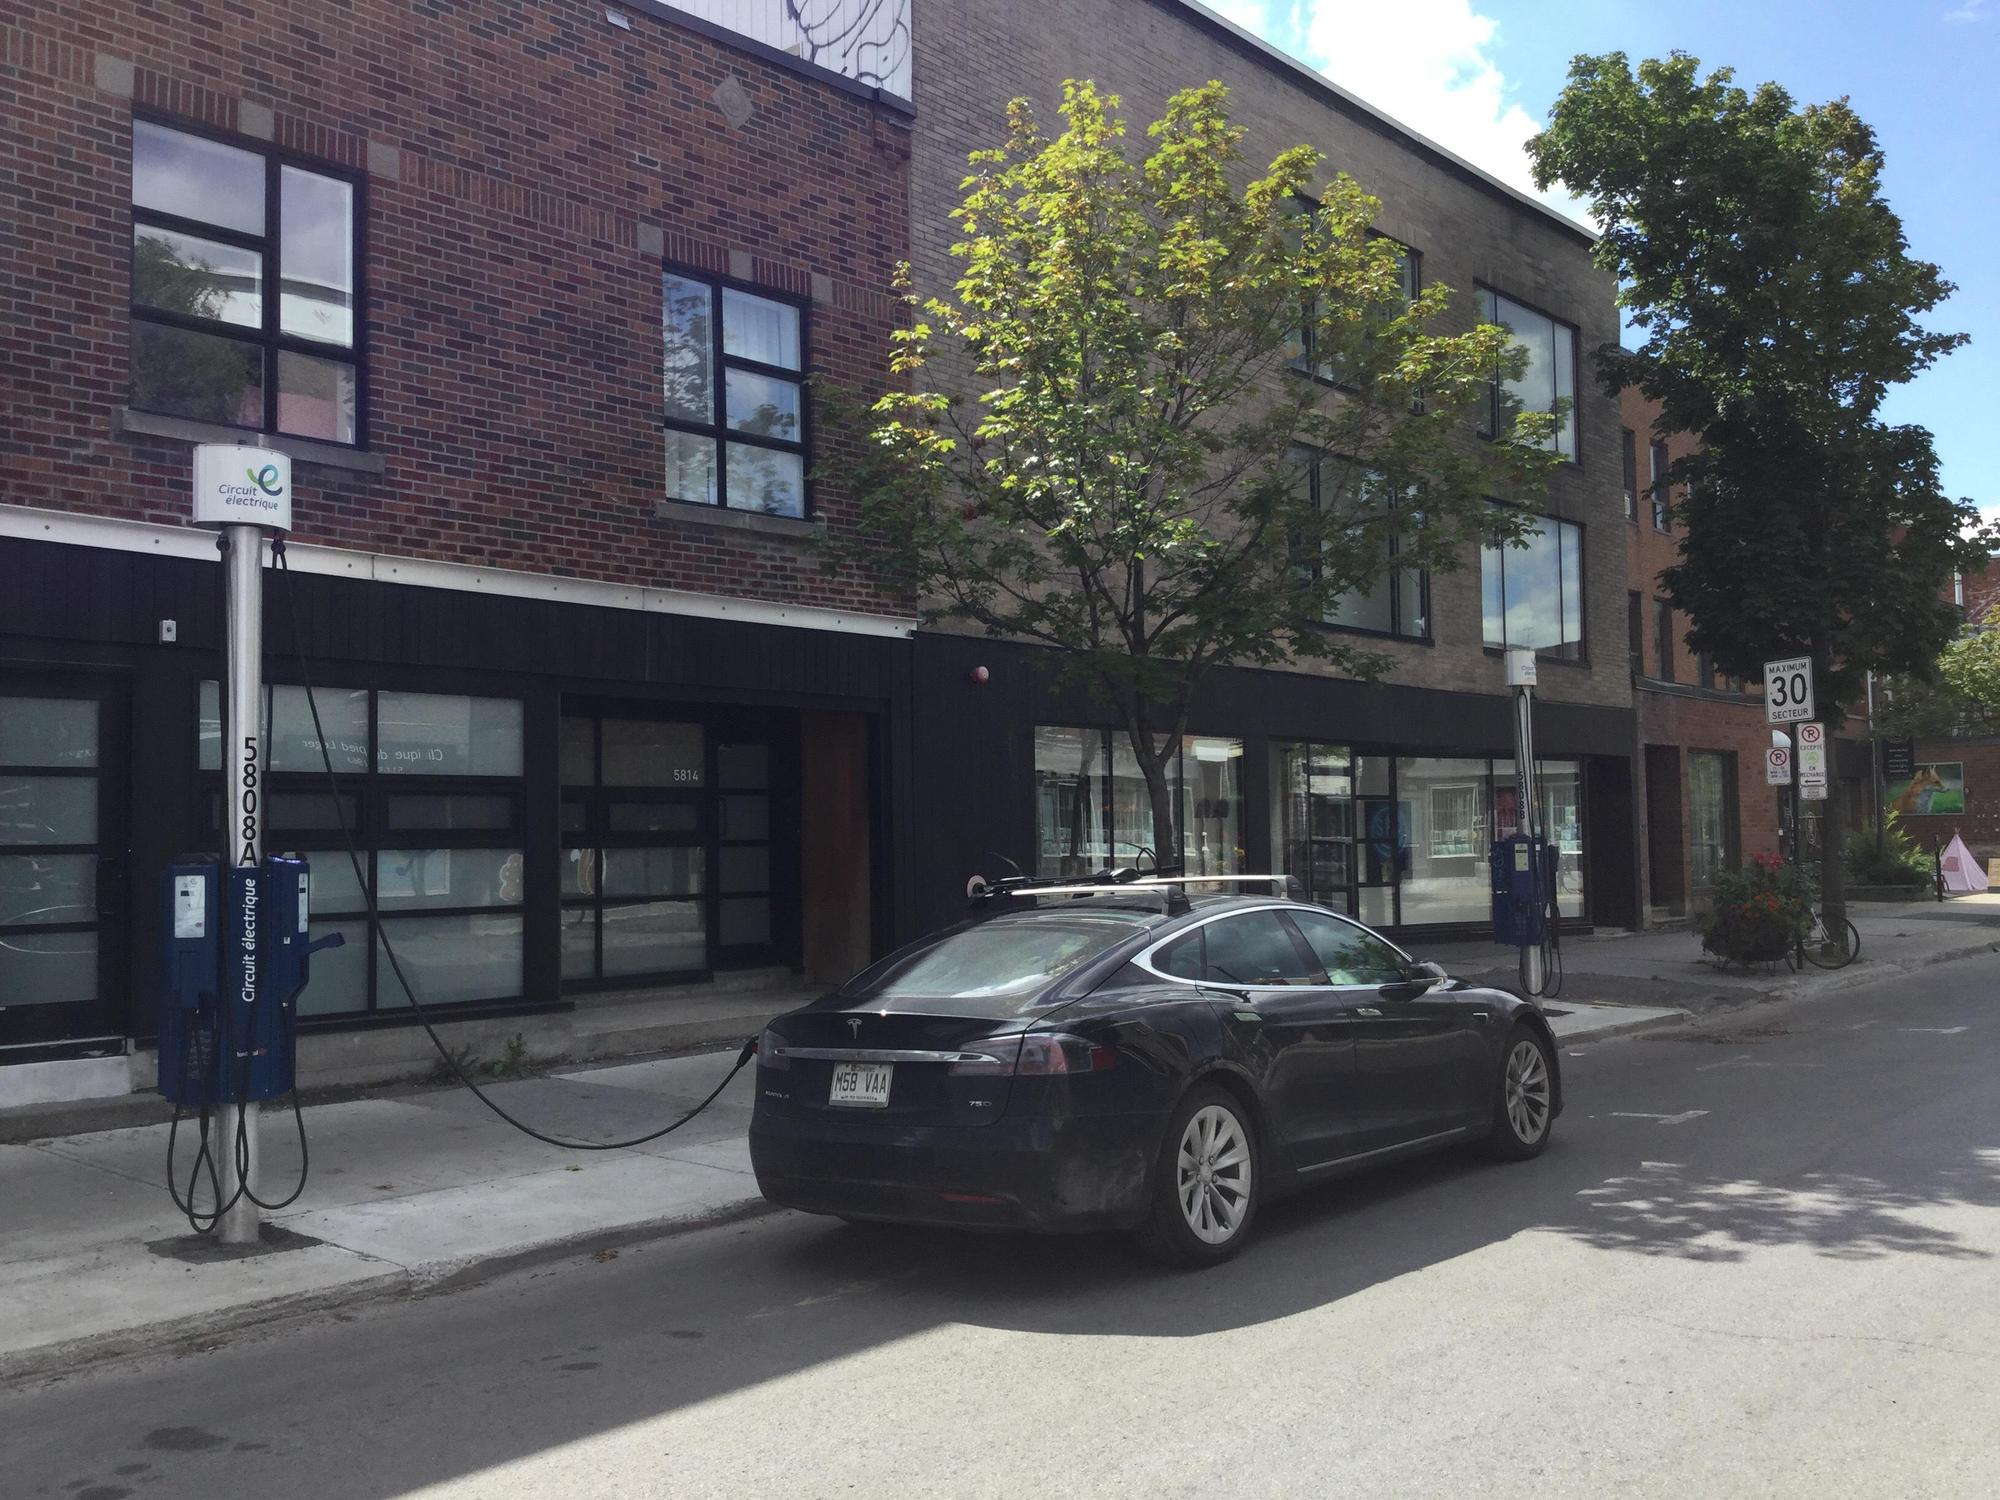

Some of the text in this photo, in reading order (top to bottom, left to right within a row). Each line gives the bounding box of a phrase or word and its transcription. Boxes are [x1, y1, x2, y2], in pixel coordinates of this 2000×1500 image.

[218, 484, 258, 496] Circuit
[225, 494, 279, 511] électrique
[1769, 662, 1807, 674] MAXIMUM
[1771, 673, 1807, 707] 30
[1772, 707, 1809, 720] SECTEUR
[673, 769, 698, 781] 5814
[239, 737, 257, 866] 5808A
[241, 878, 259, 1002] Circuit électrique
[865, 1072, 886, 1094] VAA
